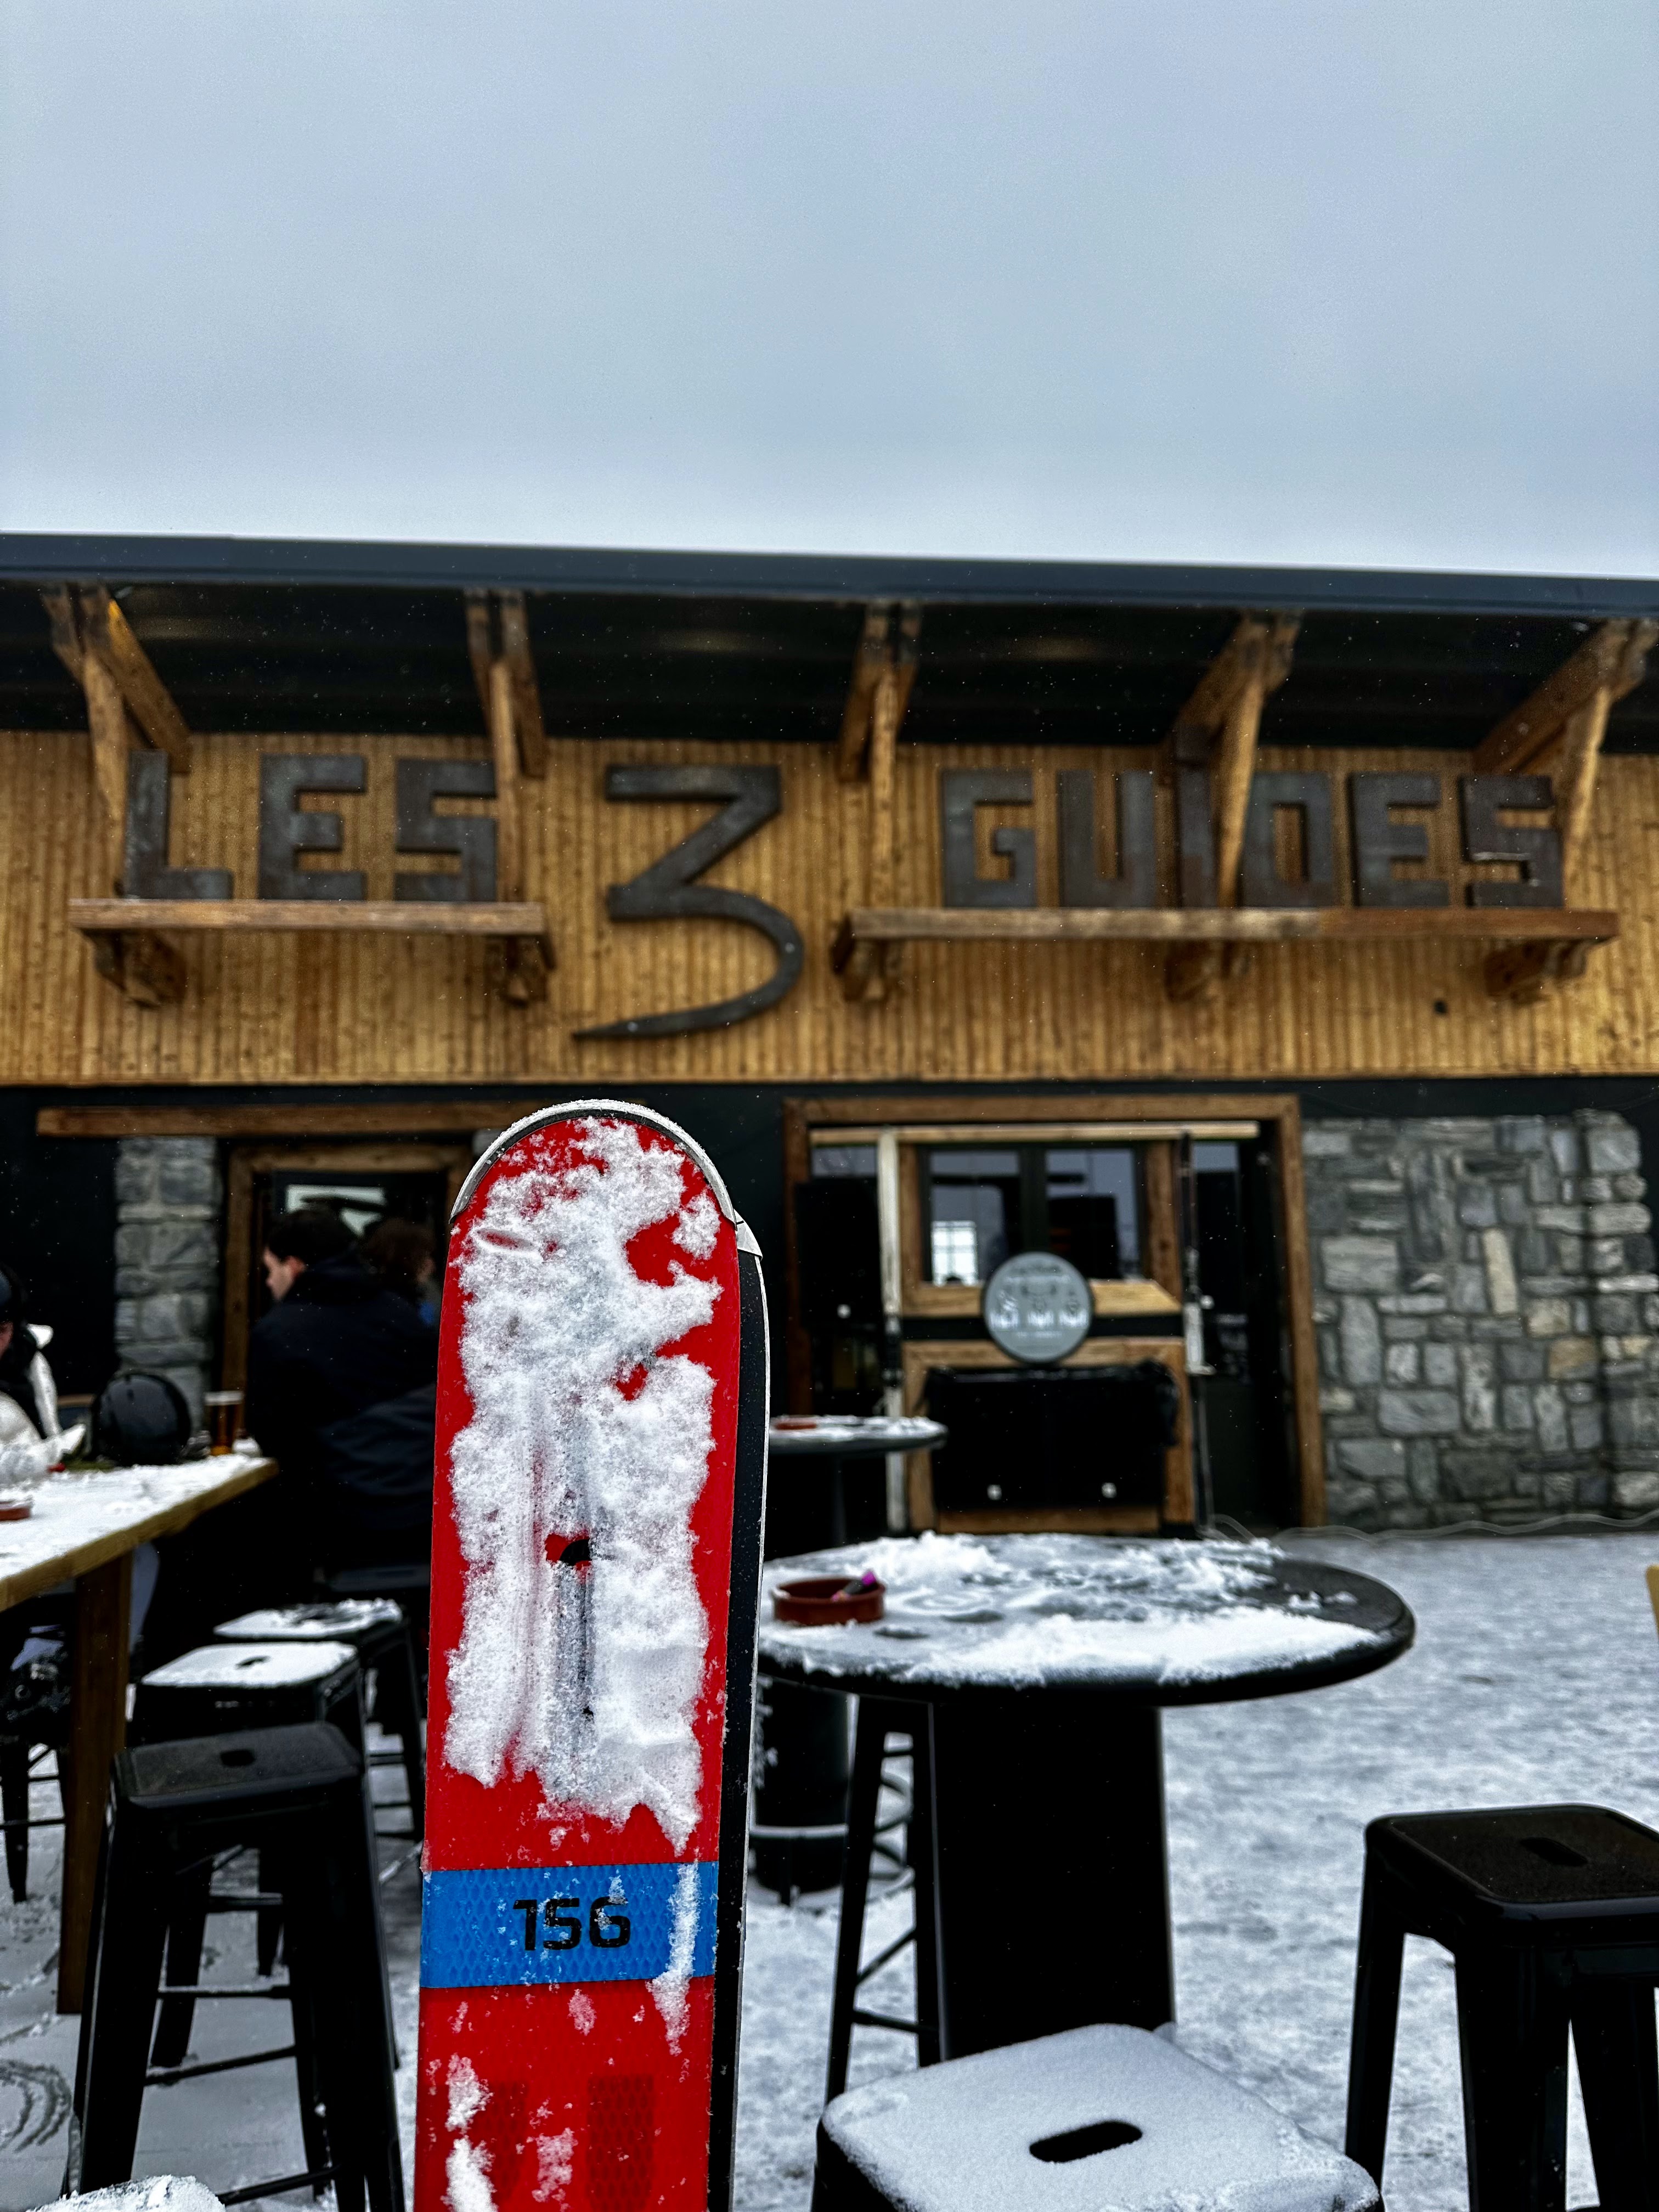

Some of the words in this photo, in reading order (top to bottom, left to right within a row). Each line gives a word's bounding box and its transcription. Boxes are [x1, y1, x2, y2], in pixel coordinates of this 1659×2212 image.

[125, 750, 498, 900] LES
[575, 765, 804, 1039] 3
[941, 769, 1565, 909] GUIDES
[513, 1897, 631, 1951] 156
